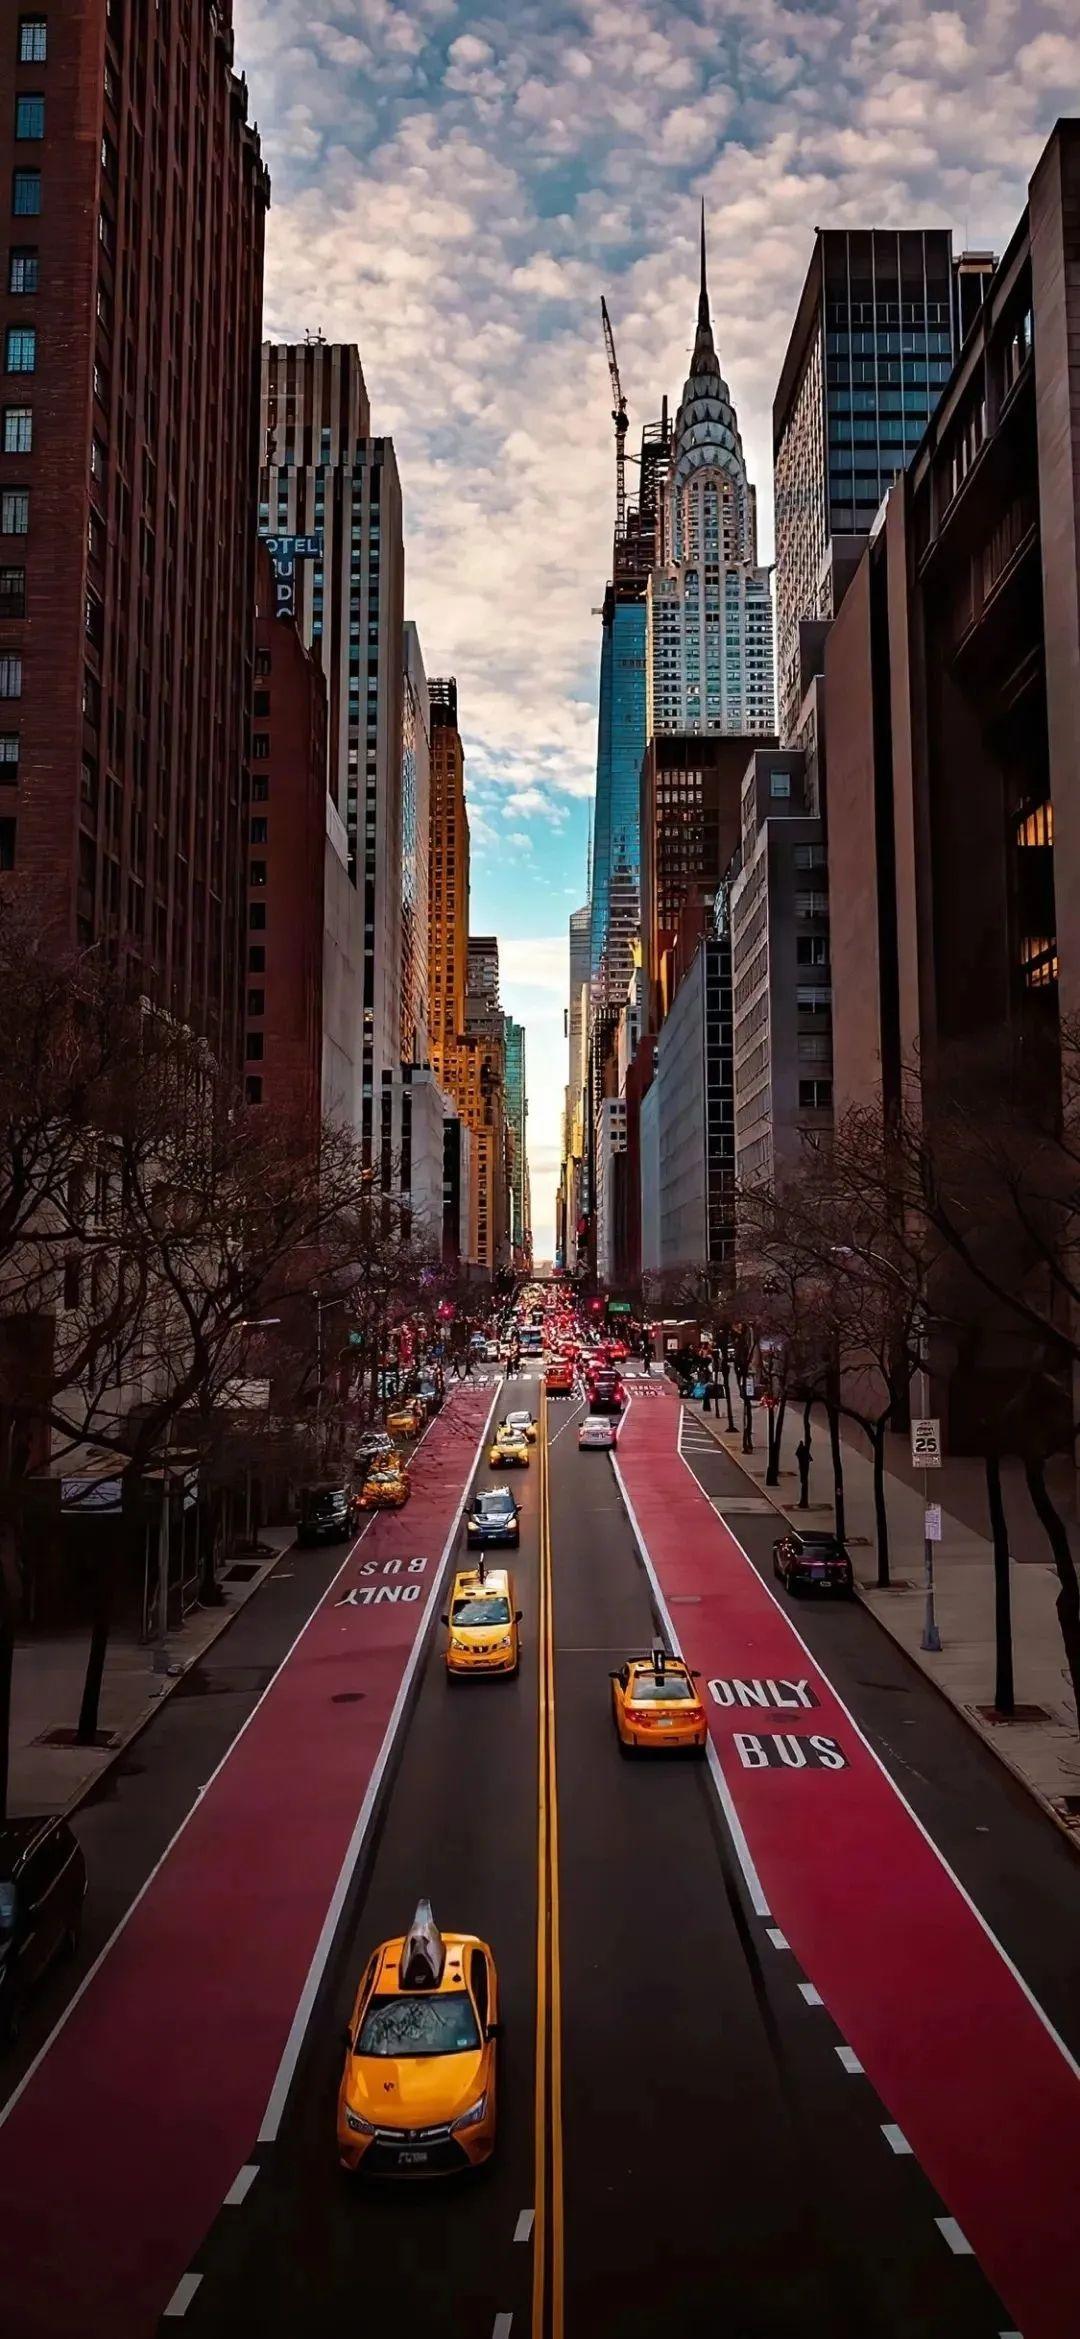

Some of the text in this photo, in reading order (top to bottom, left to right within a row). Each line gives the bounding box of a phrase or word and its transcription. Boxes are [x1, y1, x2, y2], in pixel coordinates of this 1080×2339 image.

[265, 538, 318, 554] OTEL
[915, 1438, 937, 1452] 25
[360, 1557, 428, 1576] BUS
[334, 1585, 422, 1607] ONLY
[707, 1678, 813, 1708] ONLY
[733, 1733, 846, 1770] BUS
